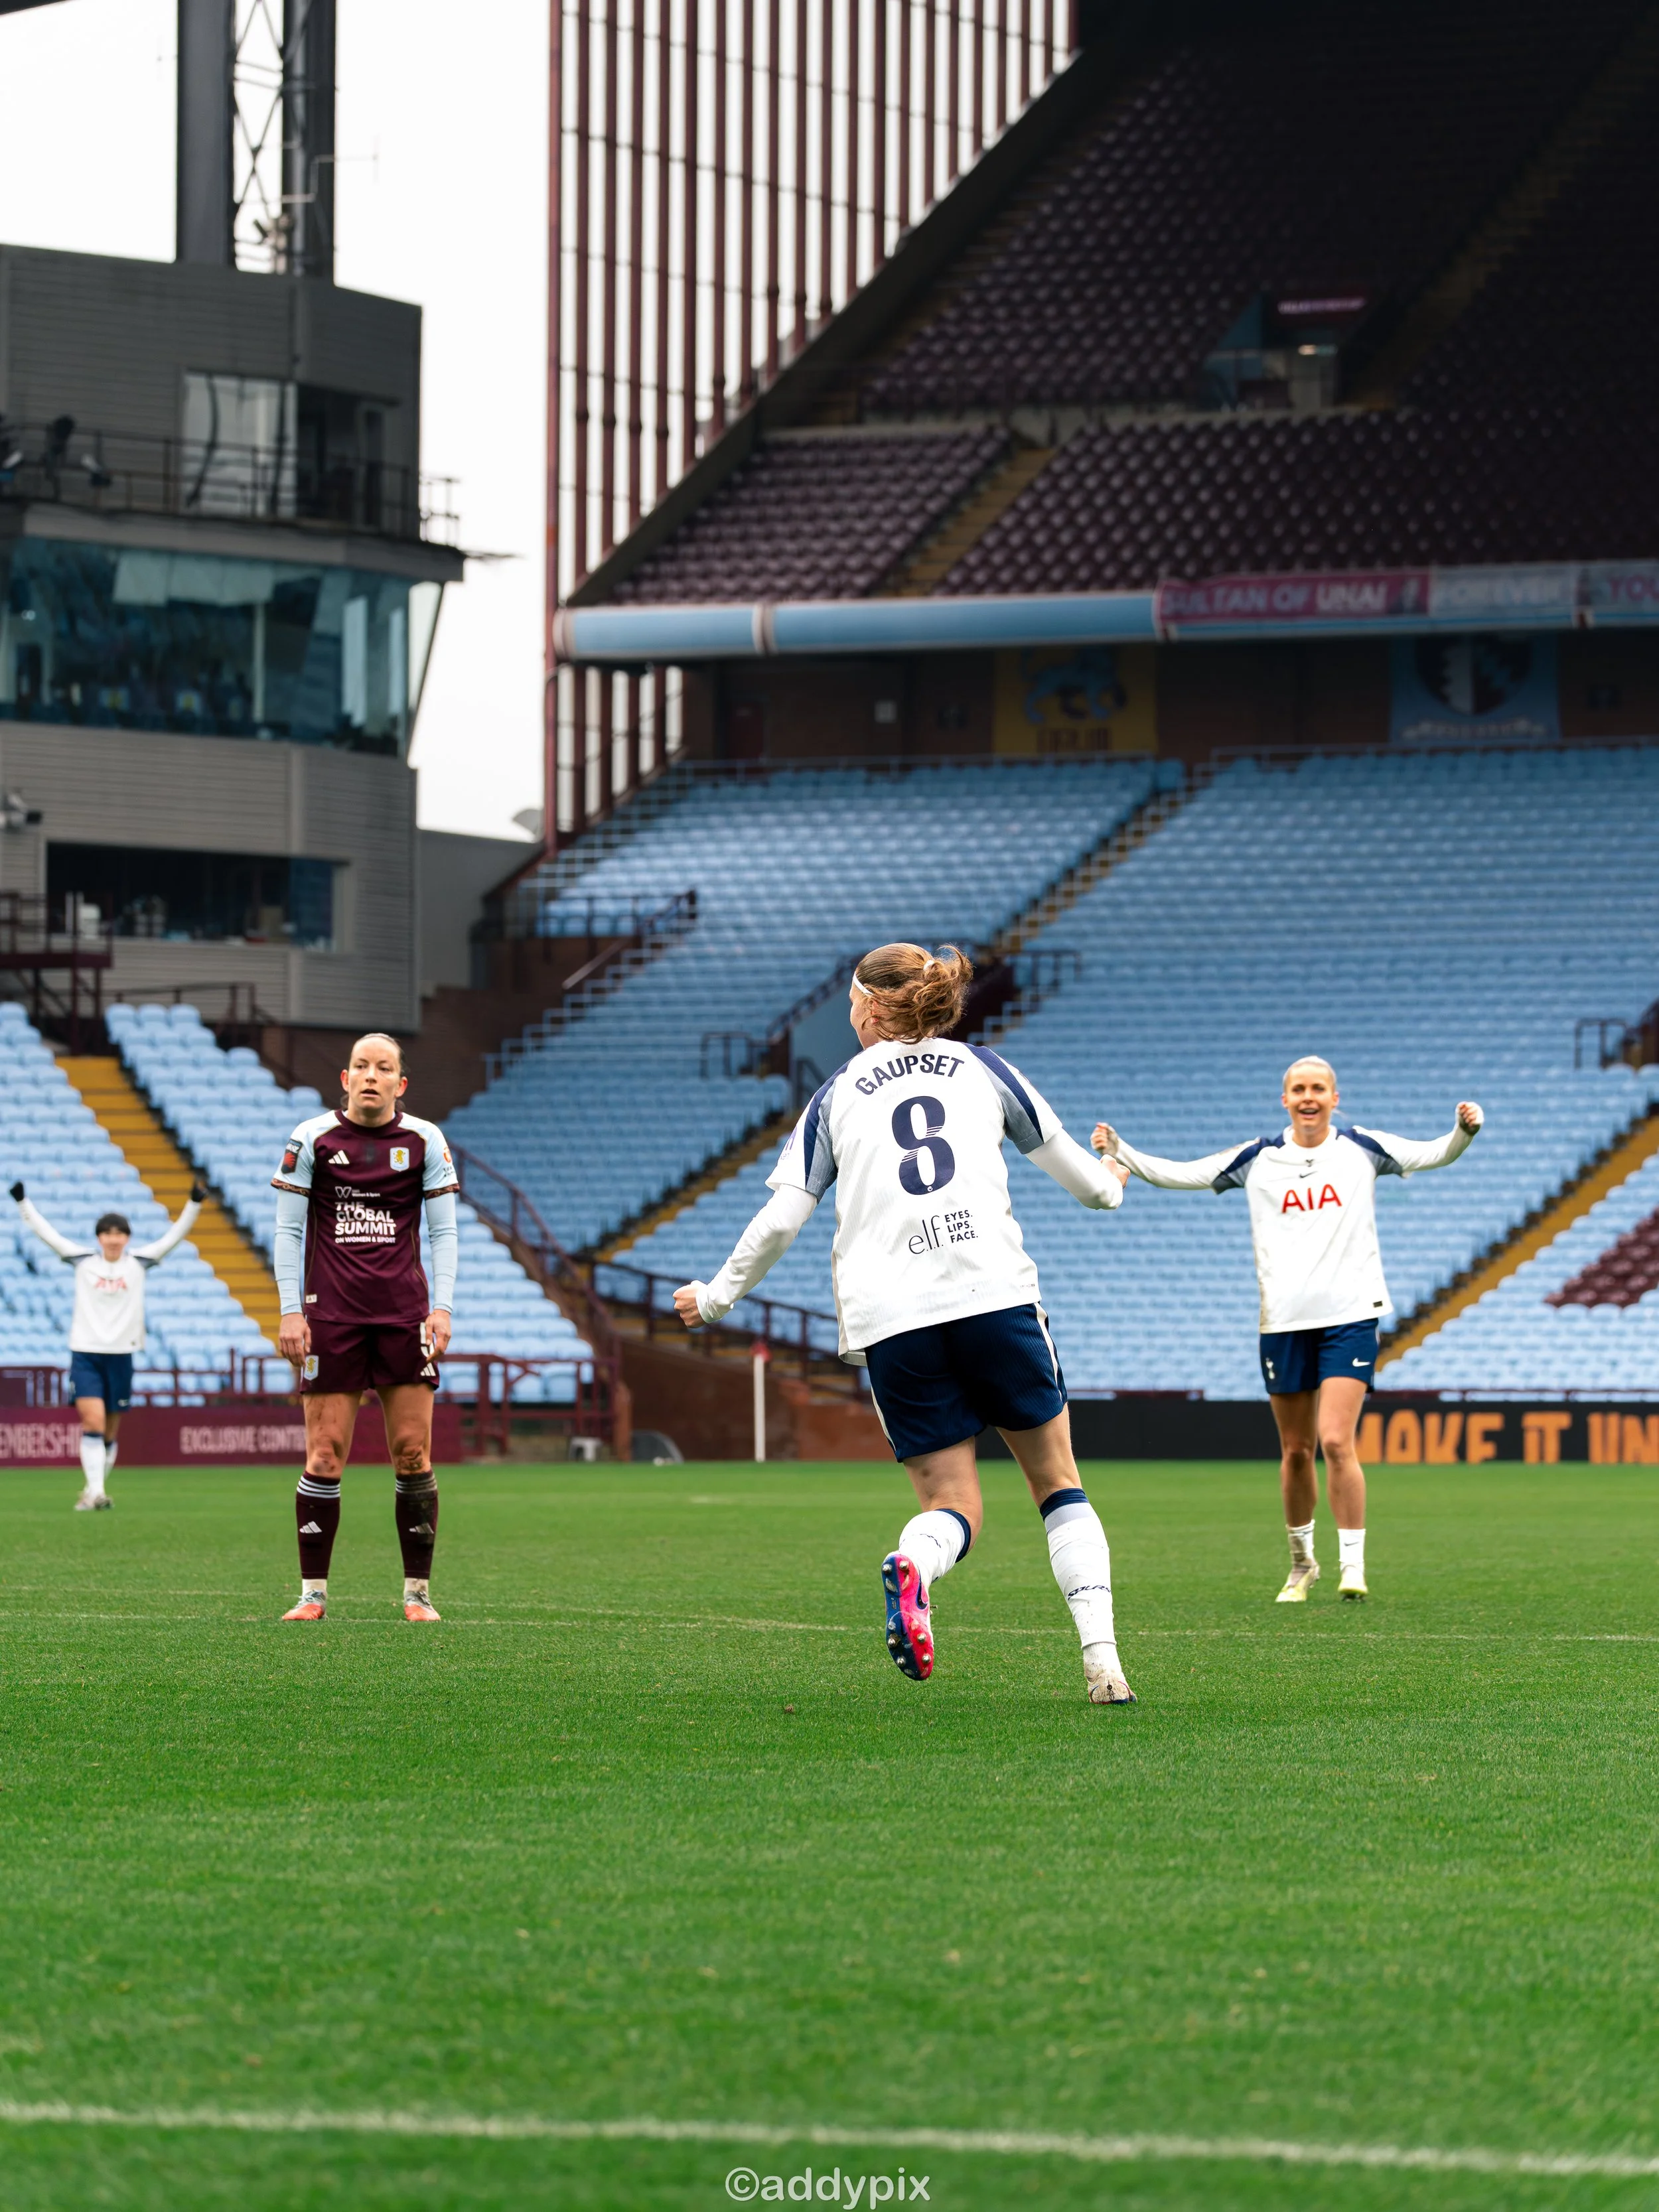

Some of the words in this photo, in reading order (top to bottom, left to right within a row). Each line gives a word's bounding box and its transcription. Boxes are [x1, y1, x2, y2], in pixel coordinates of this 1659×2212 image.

[1162, 585, 1268, 615] SULTAN
[1272, 583, 1309, 611] OF
[855, 1054, 964, 1095] GAUPSET
[892, 1095, 955, 1195] 8
[334, 1202, 364, 1211] THE
[1281, 1184, 1342, 1214] AIA
[336, 1208, 394, 1223] GLOBAL
[944, 1210, 973, 1223] EYES.
[334, 1221, 397, 1235] SUMMIT
[947, 1220, 973, 1233] LIPS.
[950, 1230, 978, 1243] FACE.
[180, 1426, 257, 1454] EXCLUSIVE
[1522, 1411, 1572, 1463] IT
